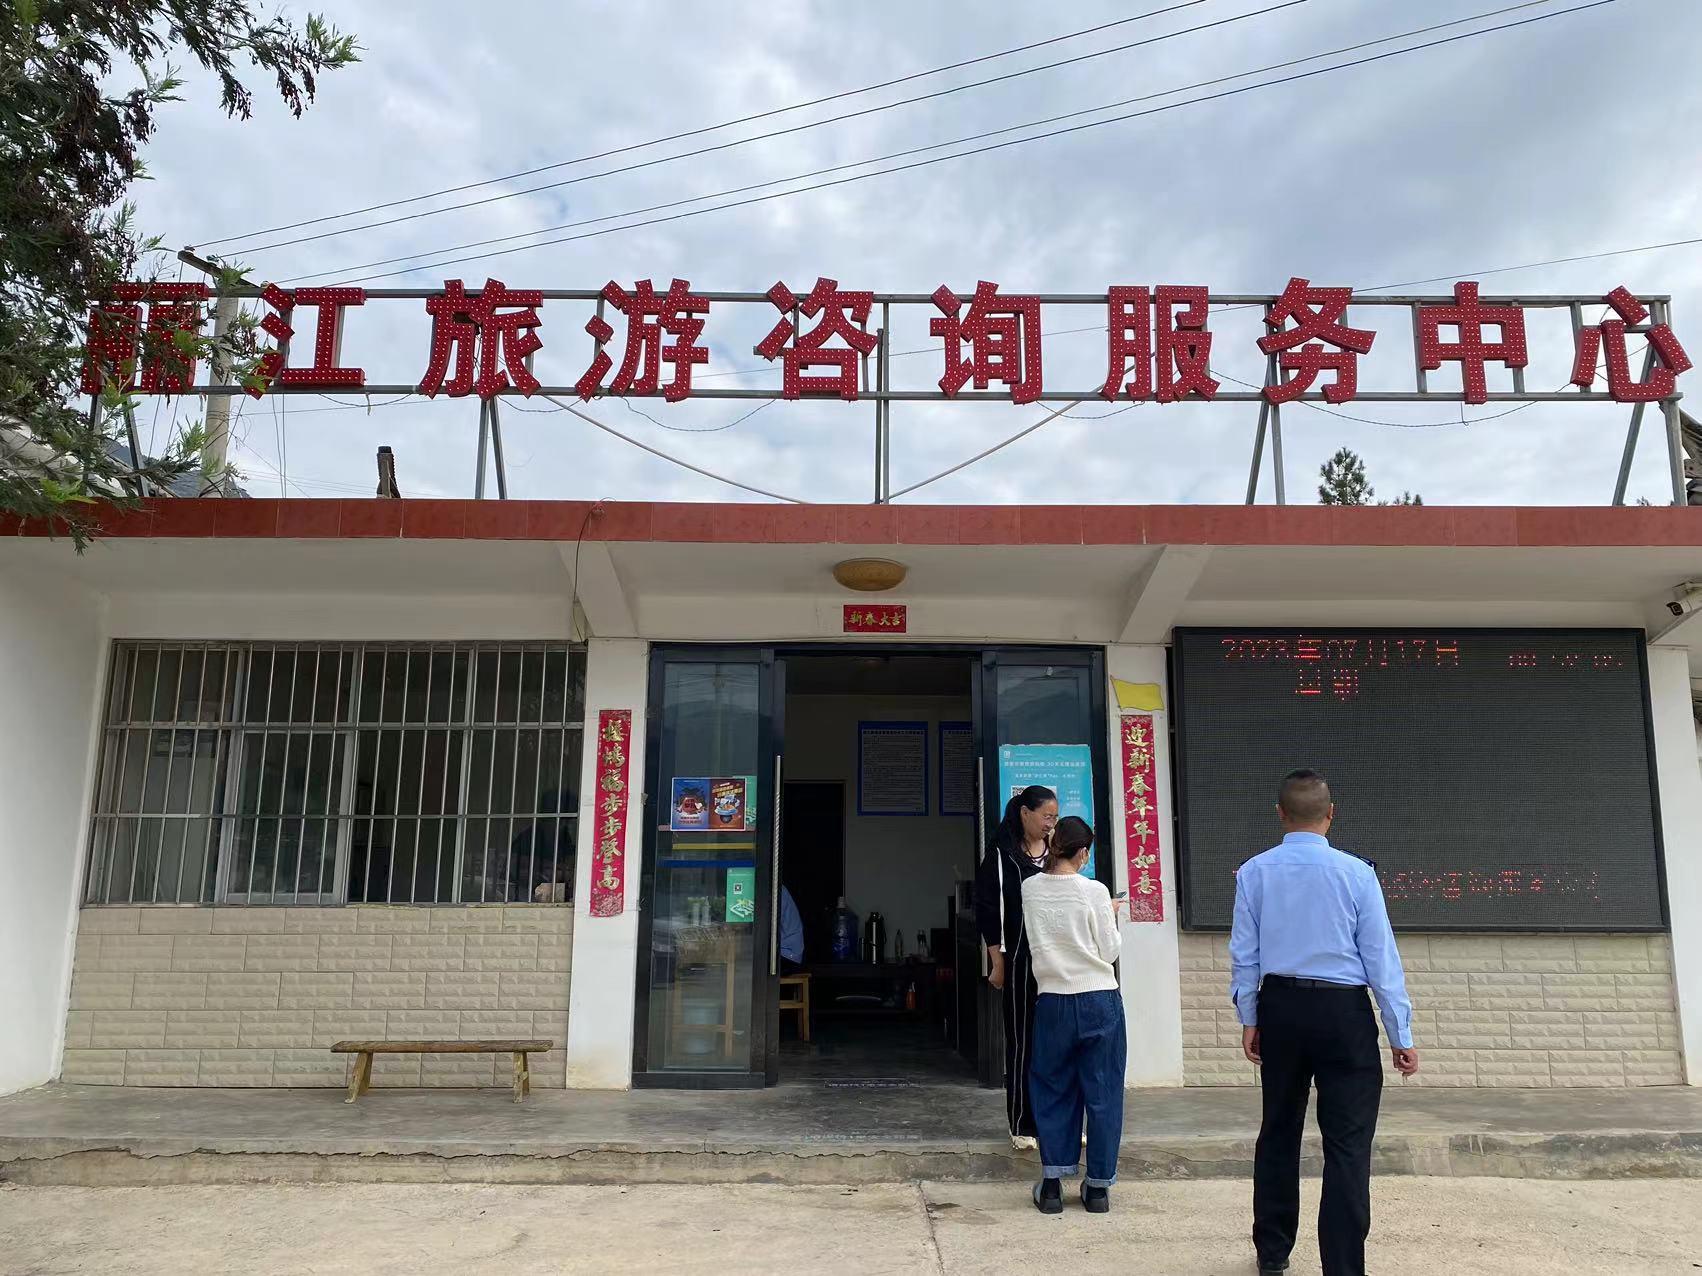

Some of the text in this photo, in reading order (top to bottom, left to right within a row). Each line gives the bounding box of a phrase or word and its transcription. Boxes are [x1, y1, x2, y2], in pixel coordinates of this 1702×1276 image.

[80, 276, 1692, 404] 丽江旅游咨询服务中心
[847, 611, 903, 626] 新春大吉
